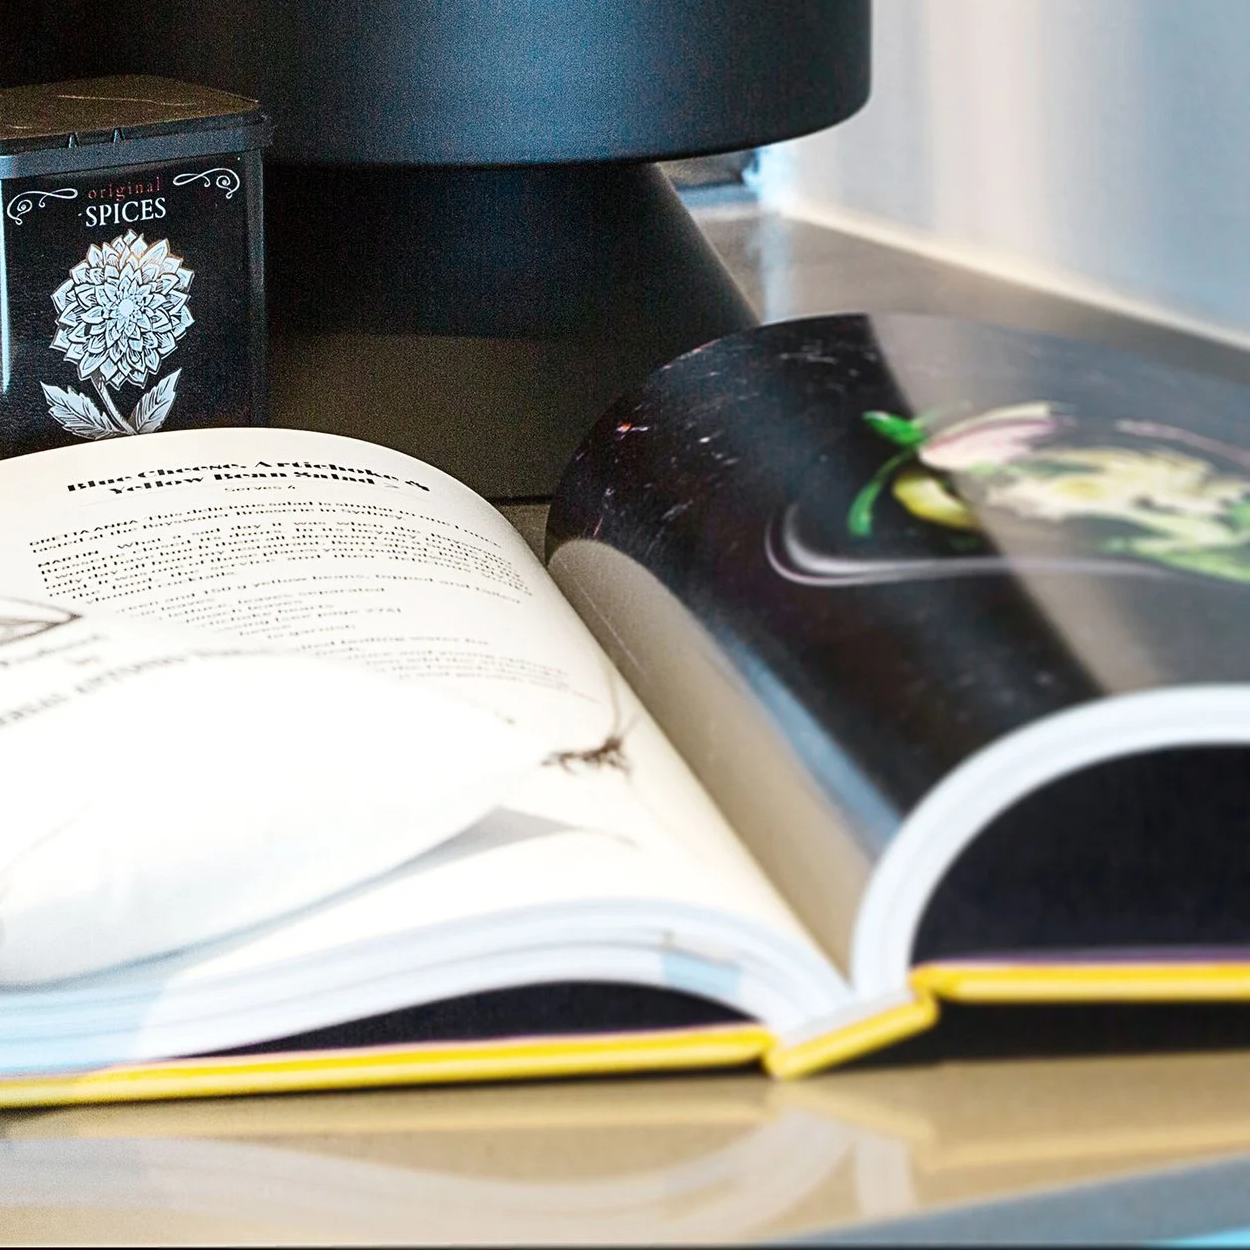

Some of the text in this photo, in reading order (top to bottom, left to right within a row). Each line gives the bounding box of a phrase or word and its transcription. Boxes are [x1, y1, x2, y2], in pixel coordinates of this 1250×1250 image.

[86, 176, 164, 201] original
[84, 197, 167, 228] SPICES
[67, 475, 133, 492] Blue
[254, 460, 399, 482] Artichoke
[109, 477, 204, 495] Yellow
[293, 471, 375, 486] Salad
